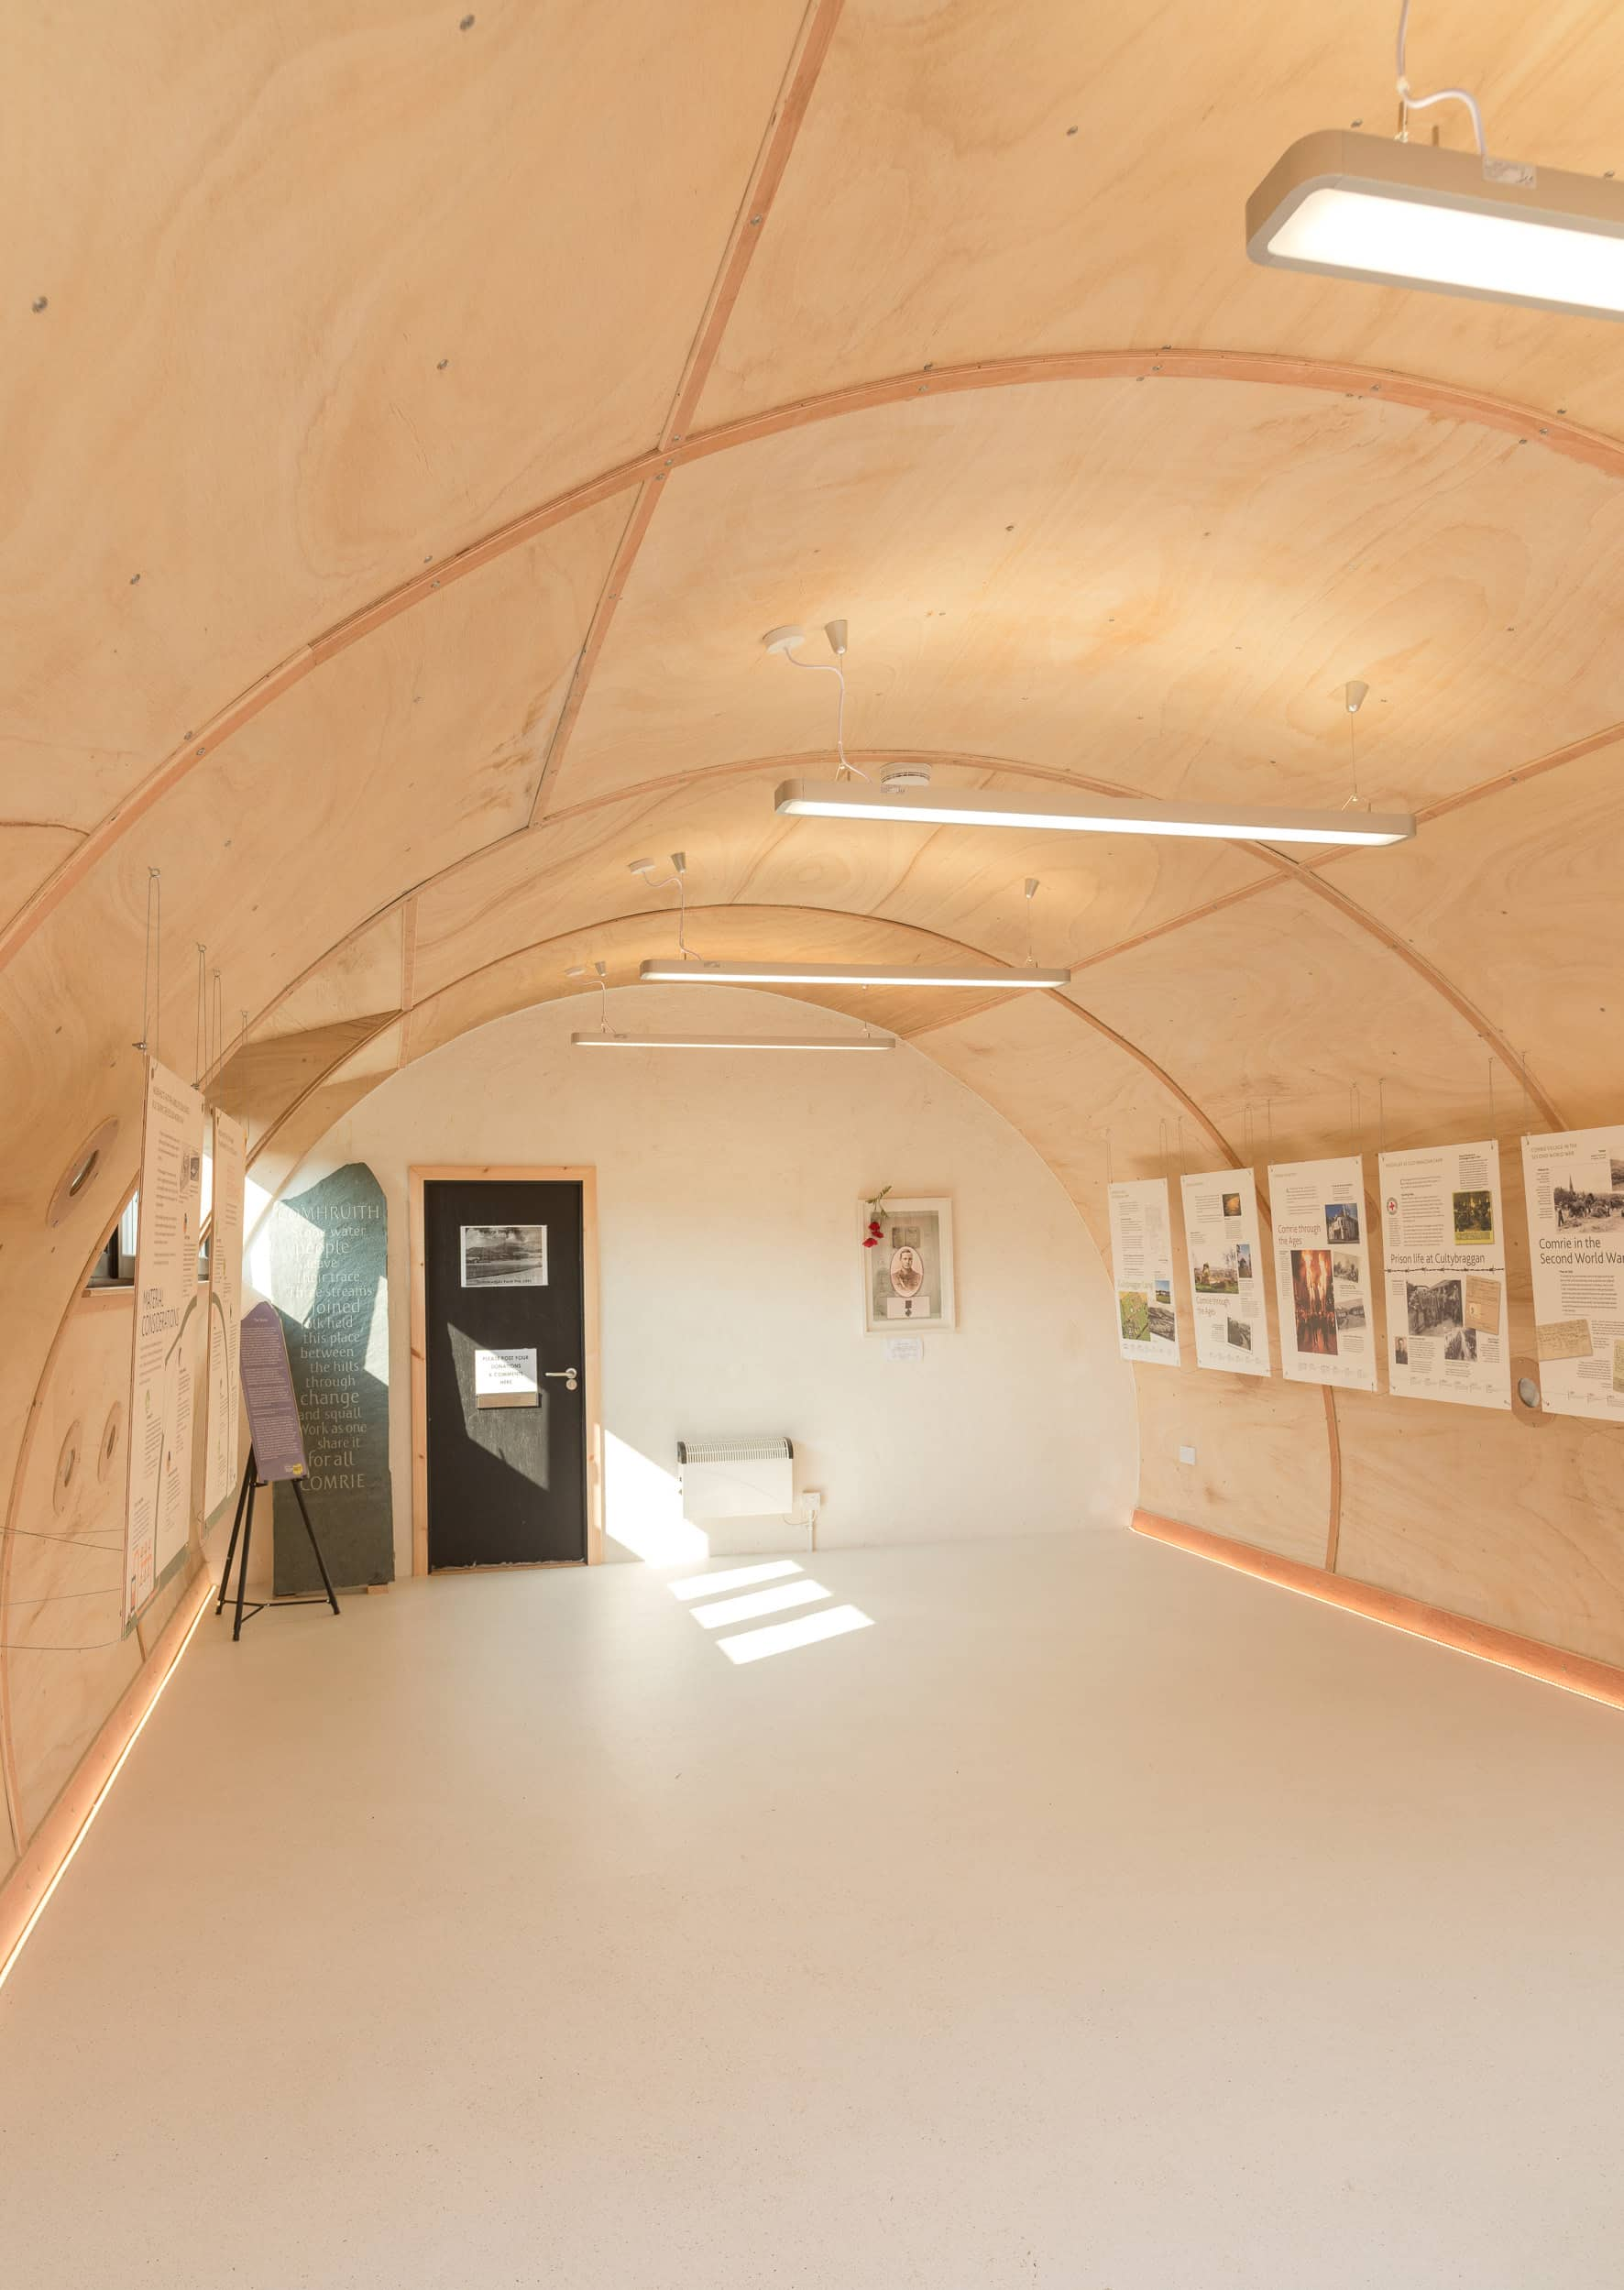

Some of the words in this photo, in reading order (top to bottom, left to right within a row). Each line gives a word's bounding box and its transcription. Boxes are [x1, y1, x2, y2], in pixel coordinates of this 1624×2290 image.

[331, 1225, 367, 1237] water
[1299, 1223, 1321, 1236] through
[1289, 1236, 1302, 1247] Ages
[1539, 1237, 1572, 1249] Comrie
[1575, 1236, 1583, 1248] in
[1585, 1236, 1601, 1248] the
[294, 1239, 350, 1258] people
[1390, 1254, 1412, 1264] Prison
[1413, 1253, 1424, 1264] life
[1426, 1255, 1433, 1264] at
[1435, 1253, 1486, 1266] Cultybraggan
[1541, 1253, 1573, 1265] Second
[1575, 1252, 1604, 1265] World
[331, 1272, 360, 1283] trace
[324, 1286, 373, 1298] streams
[313, 1298, 361, 1317] joined
[327, 1315, 353, 1330] held
[303, 1331, 326, 1344] this
[330, 1331, 360, 1346] place
[300, 1347, 355, 1359] between
[310, 1362, 331, 1373] the
[334, 1361, 360, 1372] hills
[306, 1375, 356, 1390] through
[300, 1389, 360, 1408] change
[300, 1408, 320, 1420] and
[324, 1407, 362, 1422] squall
[331, 1425, 344, 1434] as
[346, 1423, 368, 1433] one
[317, 1436, 350, 1450] share
[352, 1436, 360, 1448] it
[309, 1450, 331, 1467] for
[334, 1451, 356, 1467] all
[300, 1474, 366, 1491] COMRIE
